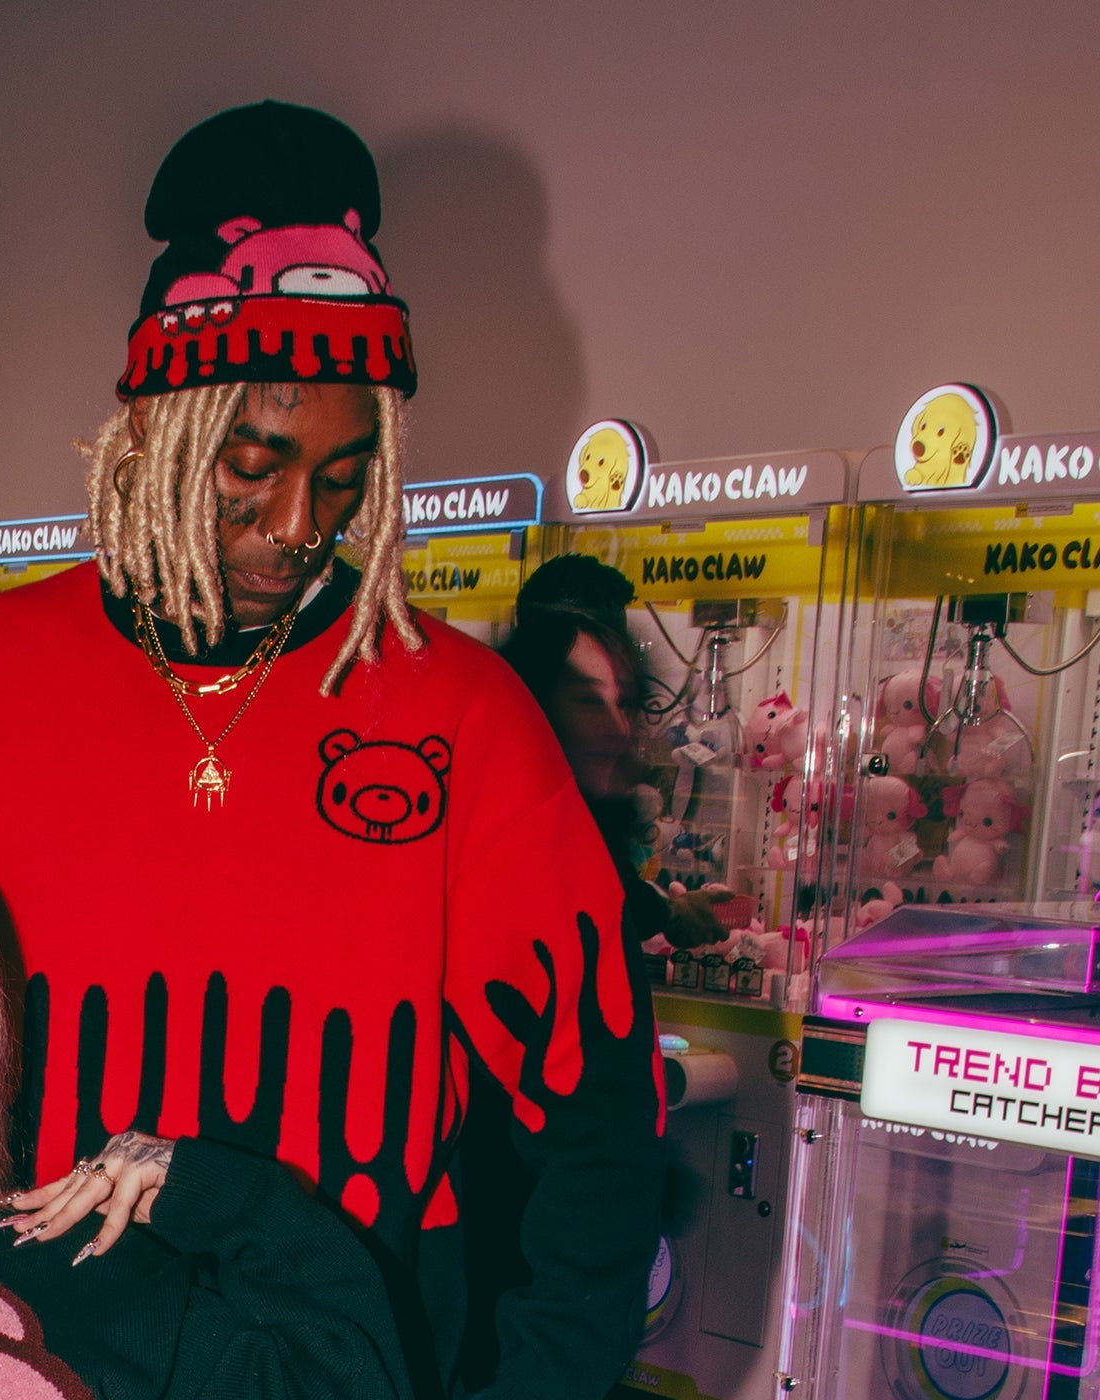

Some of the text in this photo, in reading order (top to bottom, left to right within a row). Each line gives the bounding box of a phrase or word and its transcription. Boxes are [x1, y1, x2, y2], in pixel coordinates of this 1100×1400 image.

[998, 444, 1094, 485] KAKO
[648, 464, 808, 508] KAKO CLAW
[443, 488, 509, 519] CLAW
[31, 525, 77, 551] CLAW
[642, 552, 766, 584] KAKO CLAW
[984, 541, 1057, 574] KAKO
[430, 566, 481, 591] CLAW
[775, 1045, 794, 1075] 2
[907, 1041, 1051, 1091] TREND
[932, 1314, 1005, 1349] PRIZE
